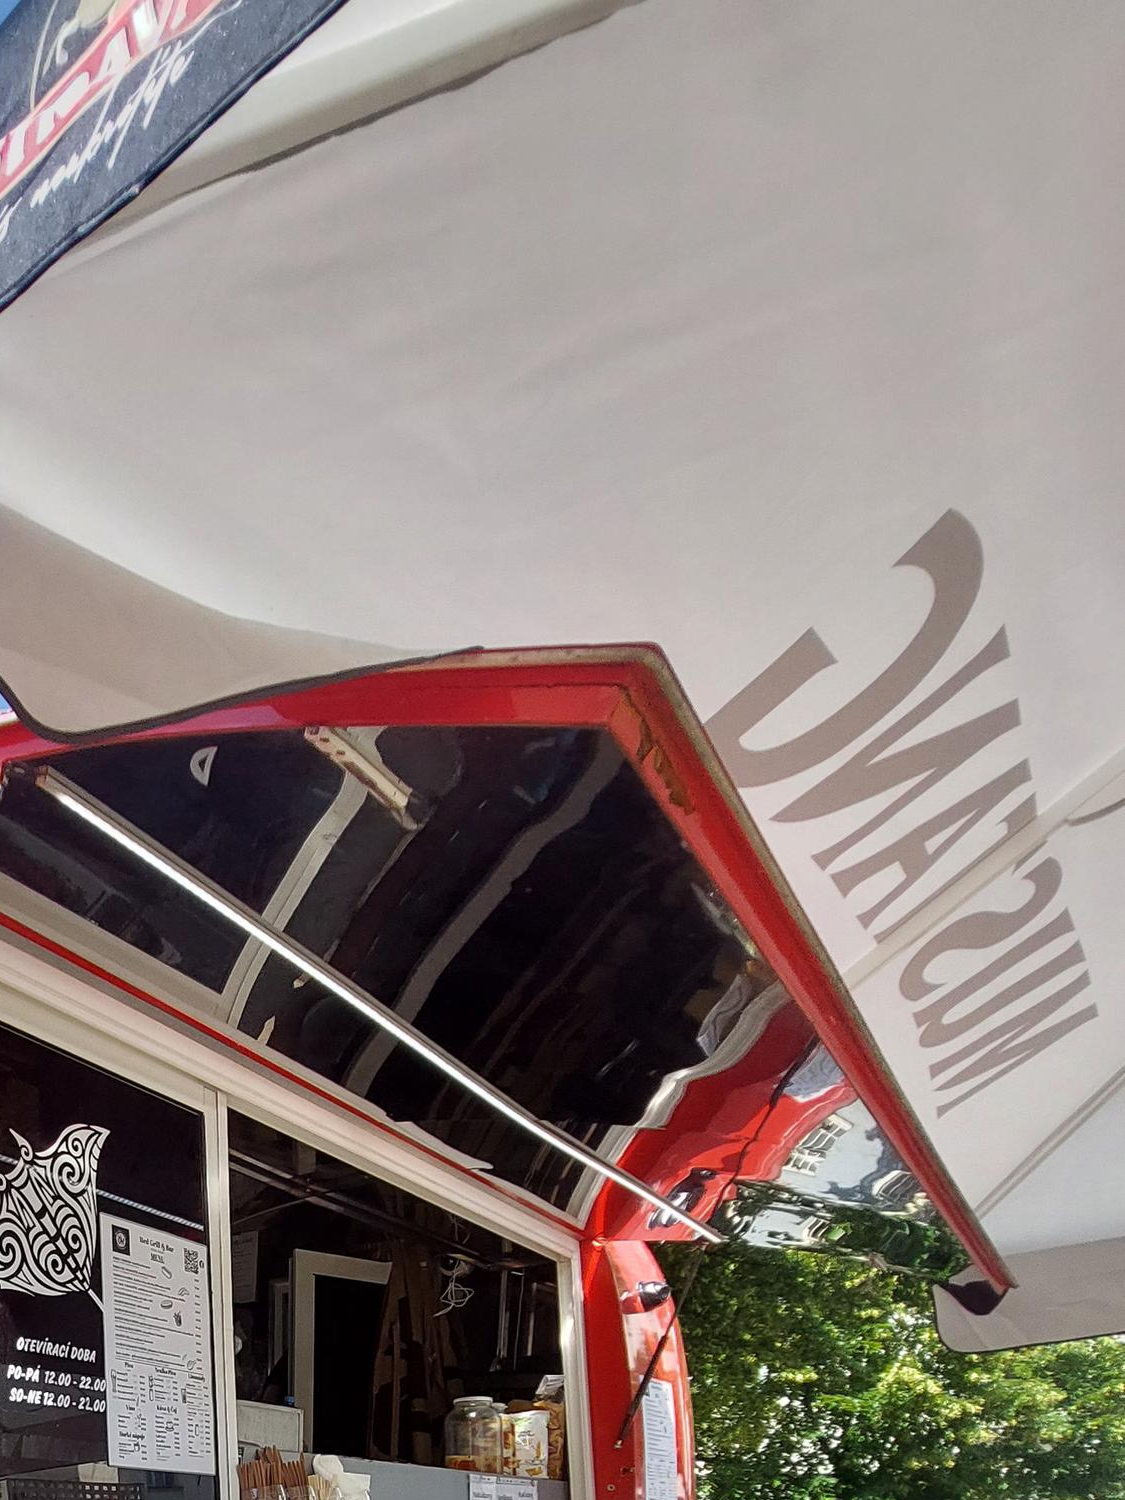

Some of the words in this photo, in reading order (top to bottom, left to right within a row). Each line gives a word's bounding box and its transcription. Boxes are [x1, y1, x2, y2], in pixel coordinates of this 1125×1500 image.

[16, 1336, 71, 1359] OTEVÍRACÍ
[70, 1346, 97, 1363] DOBA
[7, 1364, 41, 1383] PO-PÁ
[44, 1371, 72, 1387] 12.00
[79, 1376, 107, 1392] 22.00
[9, 1387, 42, 1405] SO-NE
[43, 1391, 71, 1408] 12.00
